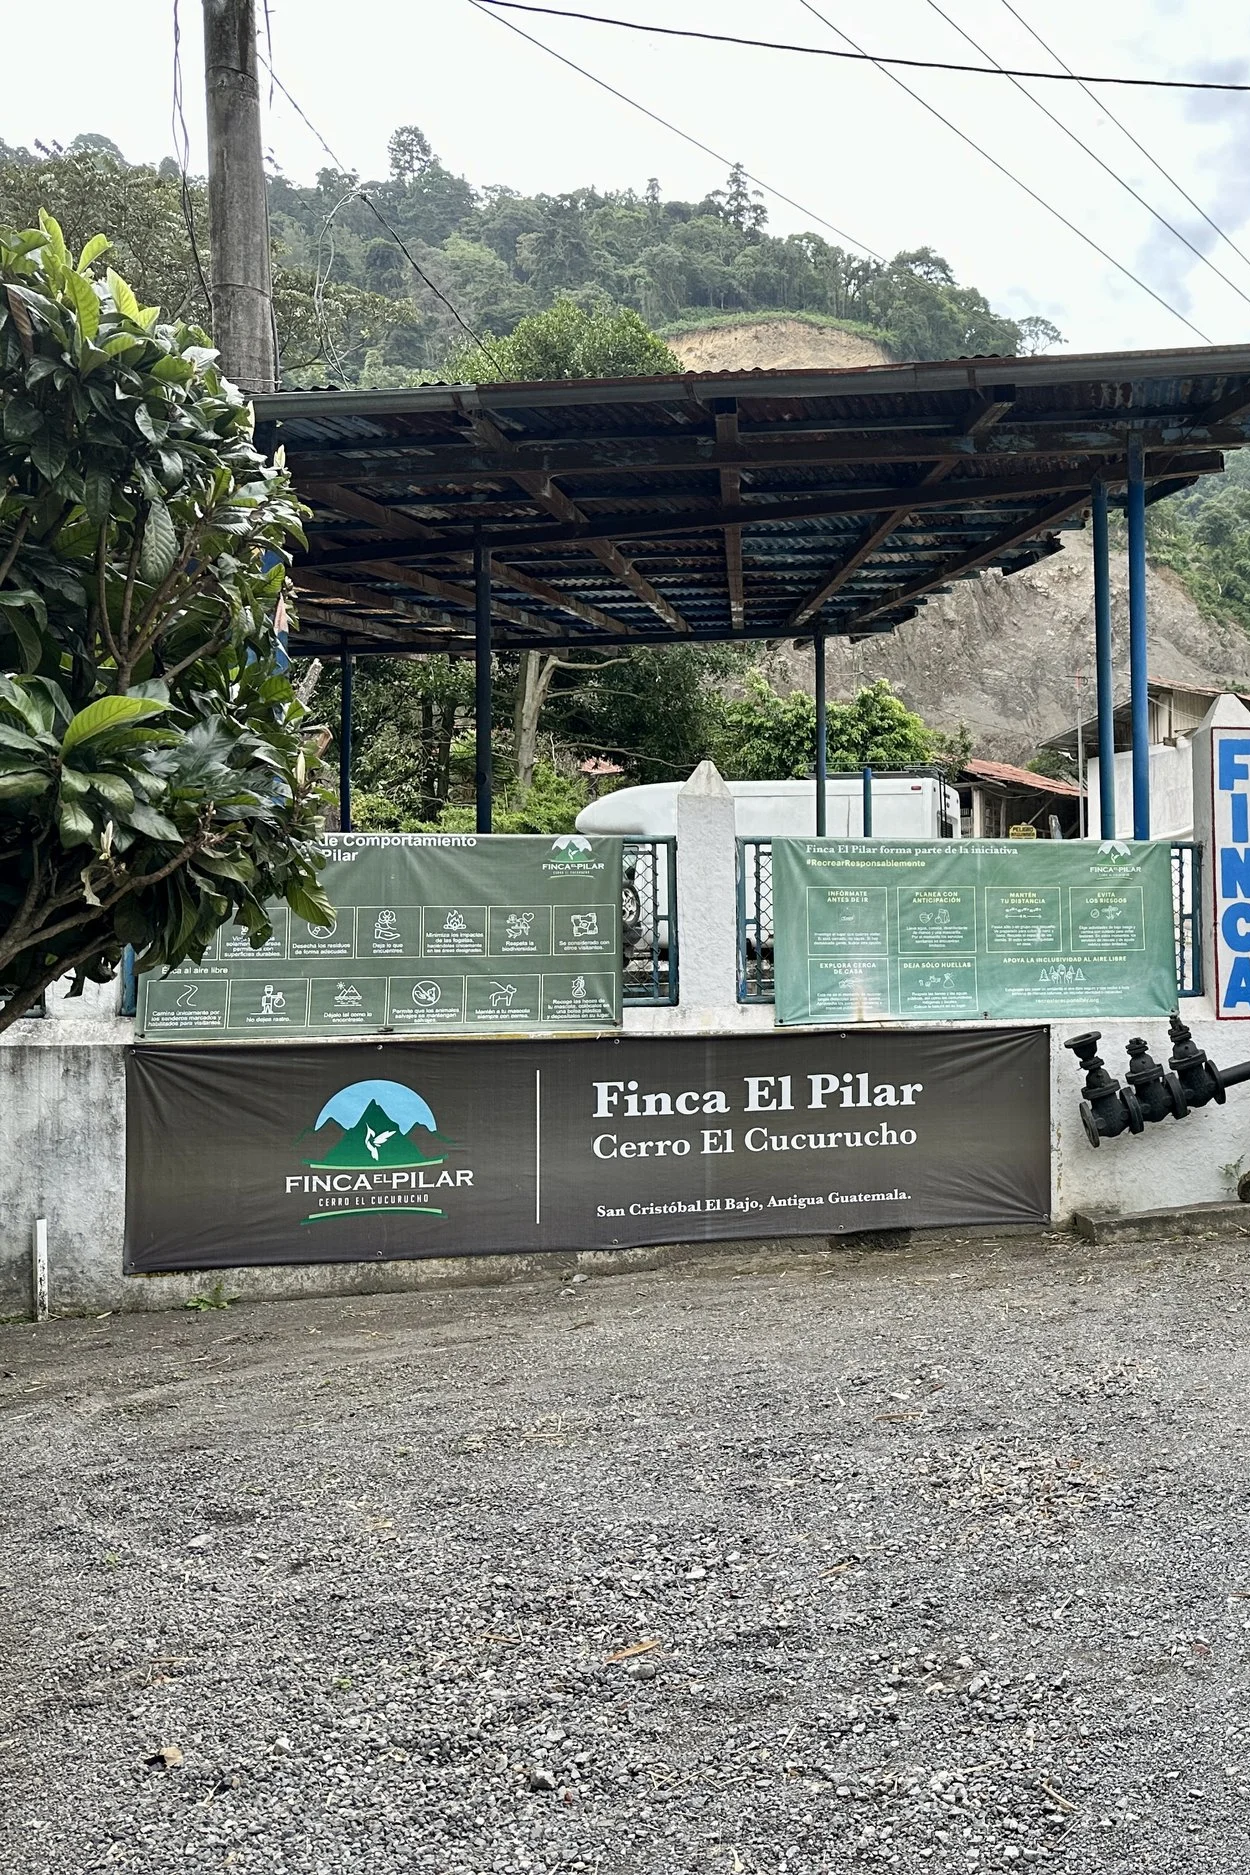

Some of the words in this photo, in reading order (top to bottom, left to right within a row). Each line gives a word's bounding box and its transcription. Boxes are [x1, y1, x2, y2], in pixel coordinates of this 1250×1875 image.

[343, 834, 477, 849] Comportamiento
[321, 849, 359, 862] Pilar
[806, 845, 834, 854] Finca
[838, 845, 849, 854] El
[851, 845, 878, 855] Pilar
[880, 845, 912, 855] forma
[915, 847, 942, 857] parte
[944, 845, 957, 855] de
[959, 845, 969, 855] la
[971, 845, 1019, 856] iniciativa
[806, 859, 926, 868] #RecrearResponsablemente
[912, 896, 961, 904] ANTICIPACIÓN
[161, 965, 182, 975] Éca
[211, 966, 229, 974] libre
[592, 1080, 731, 1118] Finca
[743, 1075, 795, 1112] El
[806, 1072, 923, 1109] Pilar
[592, 1133, 691, 1159] Cerro
[700, 1128, 735, 1154] El
[744, 1121, 917, 1152] Cucurucho
[285, 1173, 373, 1193] FINCA
[373, 1174, 392, 1184] EL
[392, 1169, 475, 1190] PILAR
[318, 1197, 350, 1207] CERRO
[355, 1196, 365, 1205] EL
[371, 1194, 429, 1206] CUCURUCHO
[596, 1205, 626, 1218] San
[629, 1200, 702, 1216] Cristóbal
[705, 1198, 721, 1212] El
[724, 1197, 764, 1212] Bajo,
[767, 1194, 825, 1210] Antigua
[828, 1188, 912, 1204] Guatemala.
